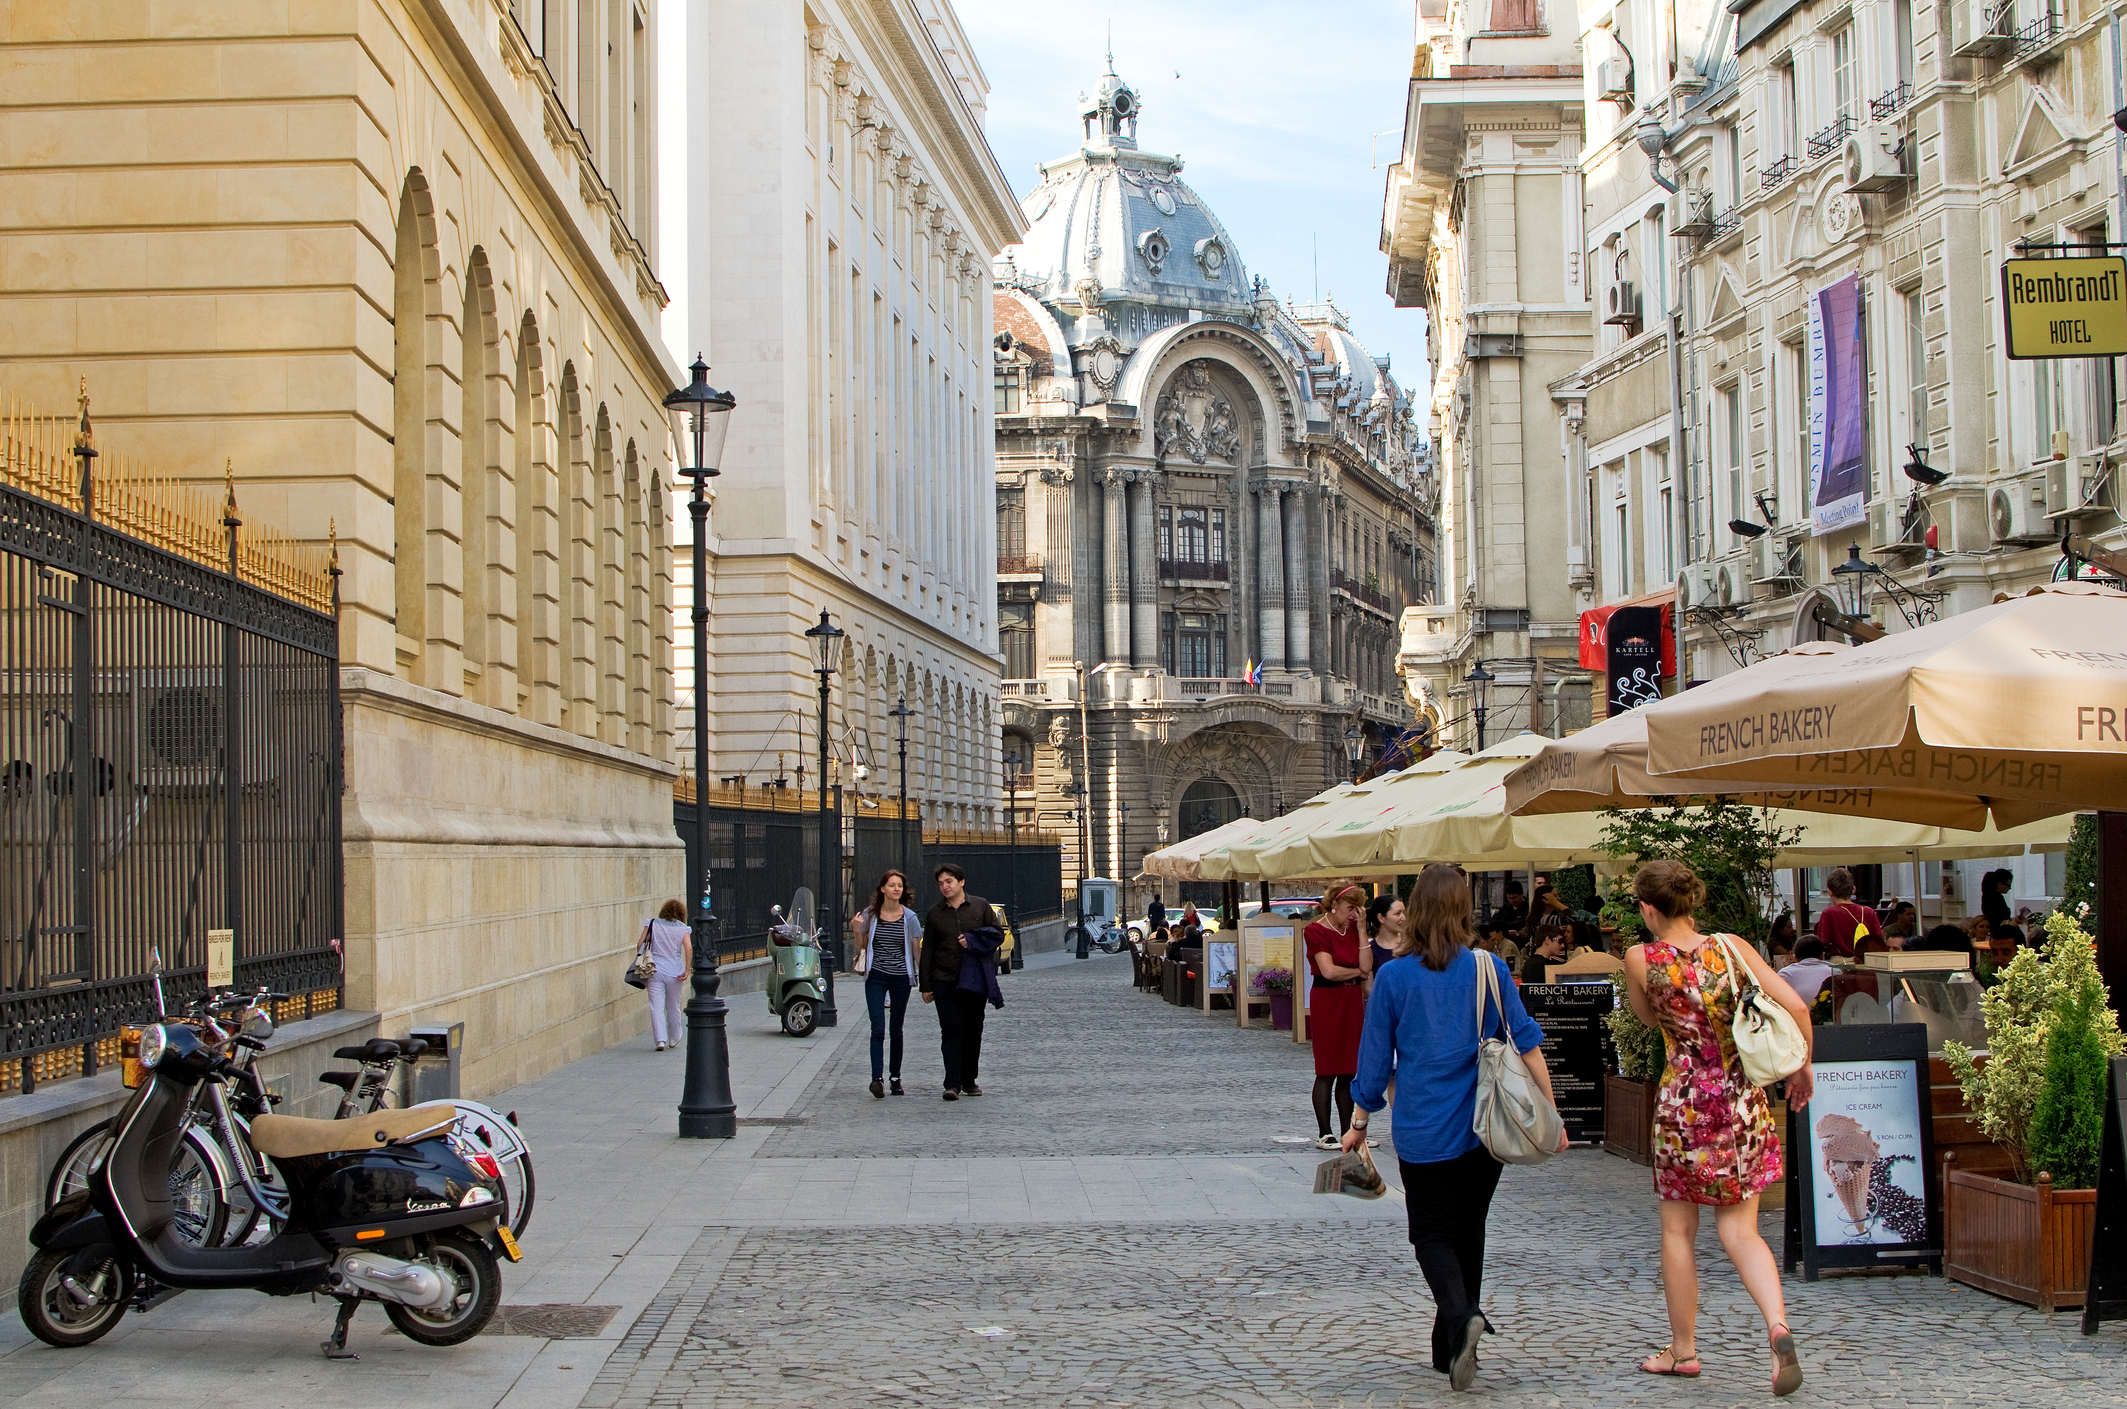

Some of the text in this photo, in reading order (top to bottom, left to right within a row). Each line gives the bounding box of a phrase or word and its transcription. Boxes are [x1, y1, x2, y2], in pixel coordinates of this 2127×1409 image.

[2049, 319, 2091, 344] HOTEL
[1820, 502, 1860, 525] Meeting Point
[1700, 704, 1837, 757] FRENCH BAKERY
[2077, 706, 2127, 742] FR
[1523, 752, 1579, 793] FRENCH BAKERY
[1528, 986, 1609, 995] FRENCH BAKERY
[1544, 995, 1555, 1005] Le
[1816, 1069, 1908, 1082] FRENCH BAKERY
[407, 1198, 452, 1213] Vespa
